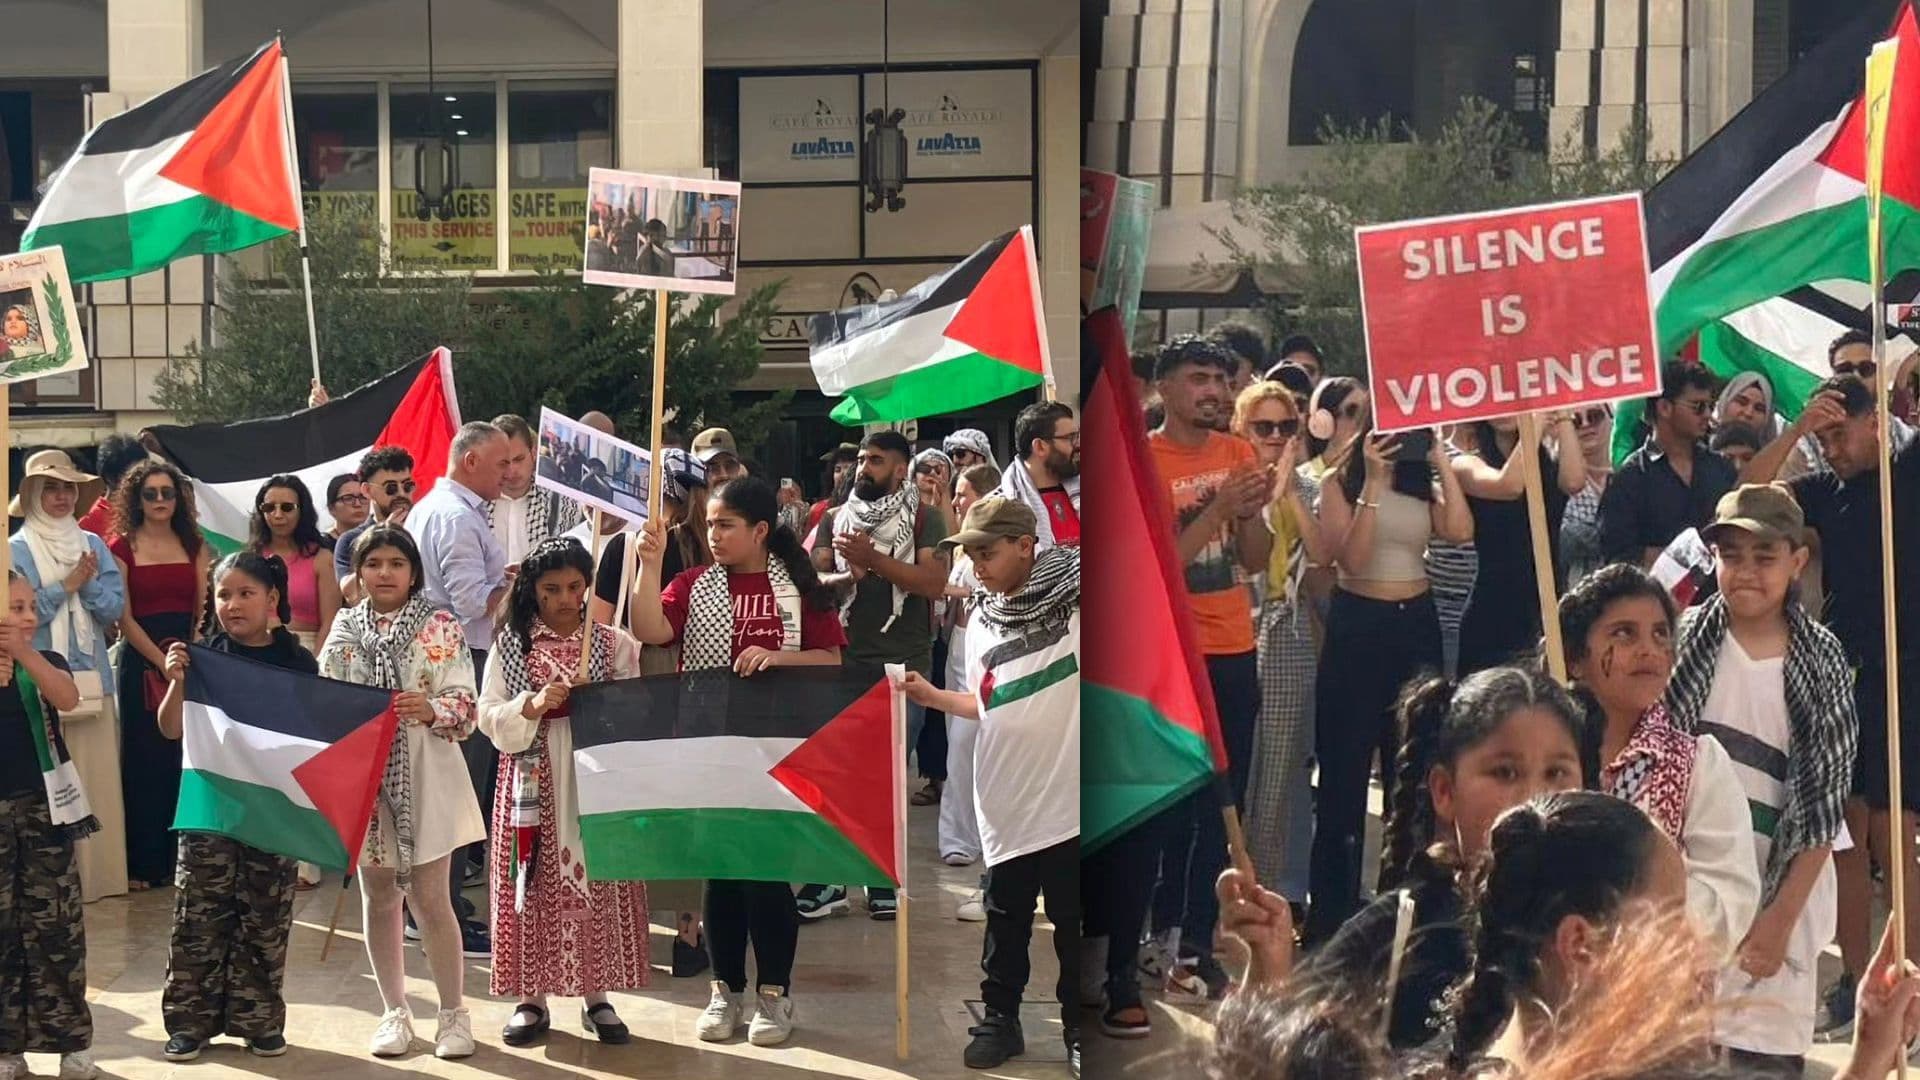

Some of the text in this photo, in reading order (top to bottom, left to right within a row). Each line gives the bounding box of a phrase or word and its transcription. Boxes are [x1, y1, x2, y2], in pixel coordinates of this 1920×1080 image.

[791, 136, 855, 155] LAVAZZA
[916, 132, 982, 151] LAVAZZA
[397, 192, 491, 219] LUAGES
[512, 192, 556, 218] SAFE
[394, 222, 428, 239] THIS
[431, 222, 495, 239] SERVICE
[1402, 218, 1604, 280] SILENCE
[766, 317, 808, 338] CA
[1480, 294, 1528, 337] IS
[1386, 345, 1643, 416] VIOLENCE
